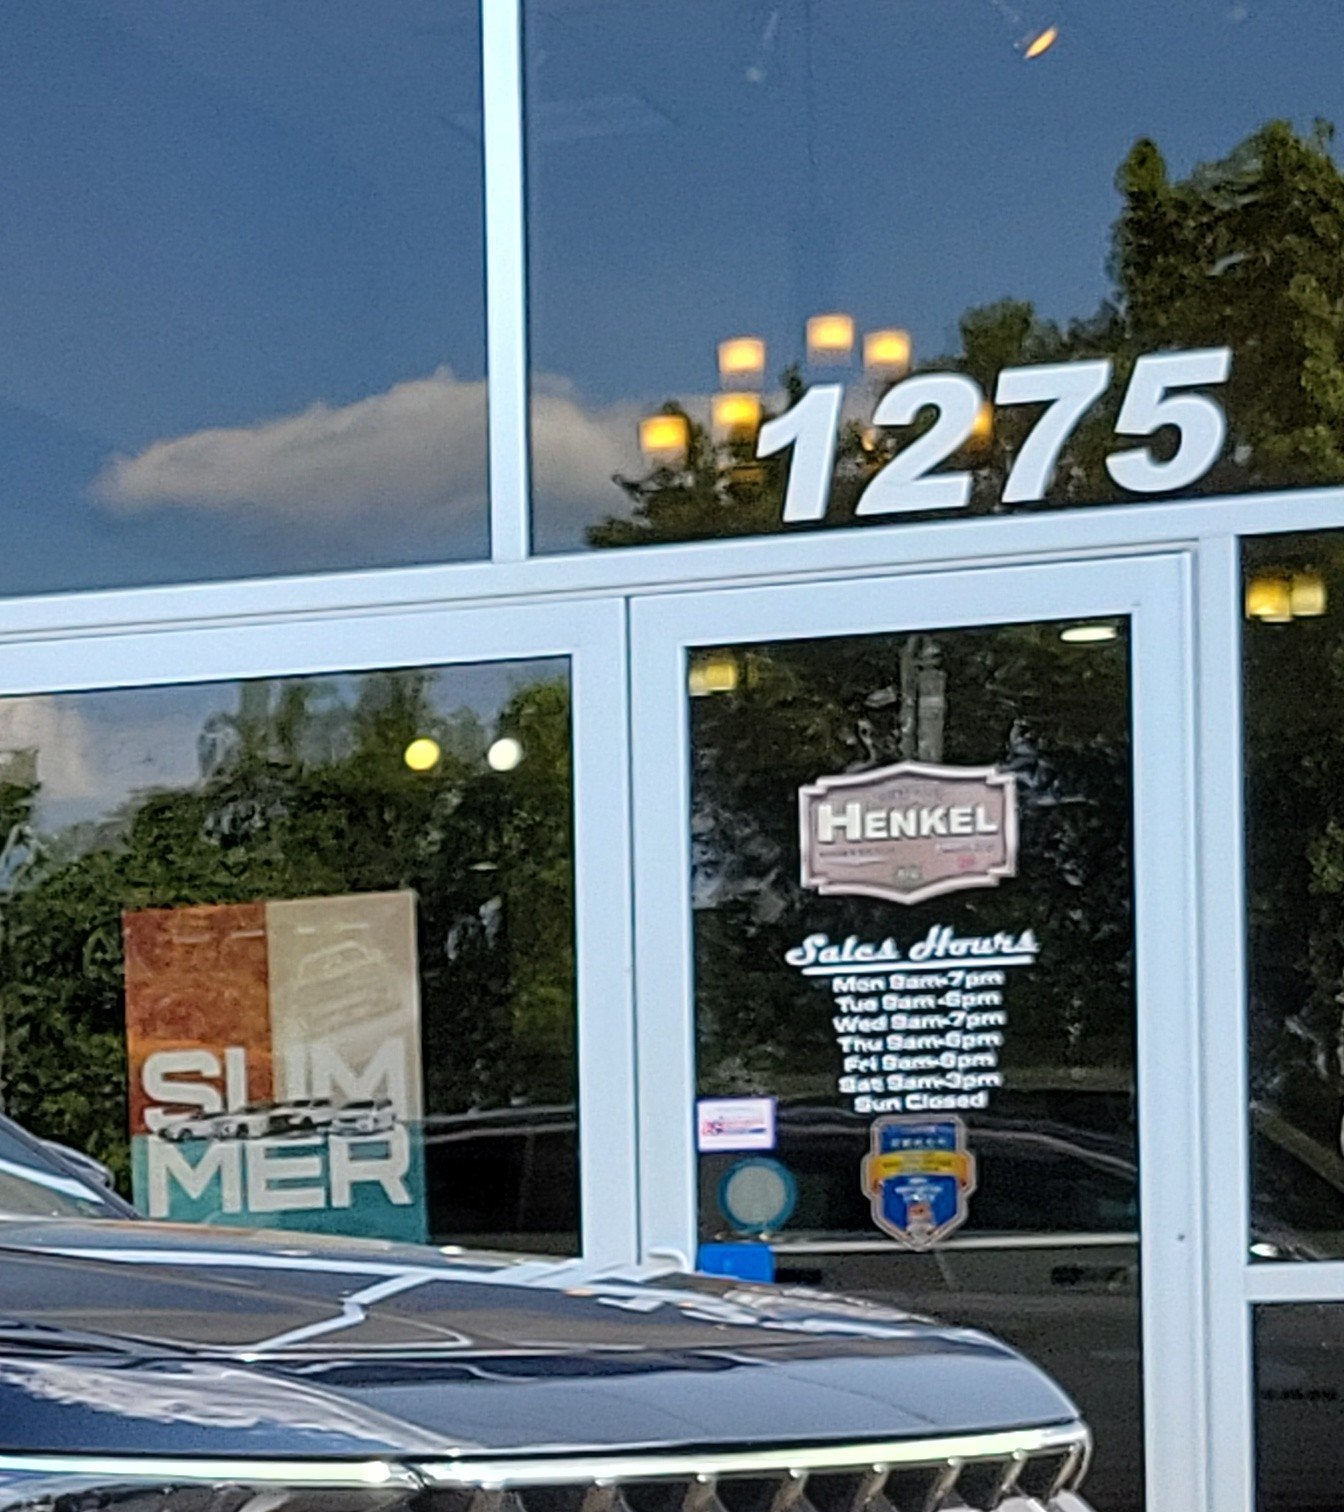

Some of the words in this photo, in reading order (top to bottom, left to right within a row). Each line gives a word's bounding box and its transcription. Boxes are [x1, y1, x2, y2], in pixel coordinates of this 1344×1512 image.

[757, 346, 1232, 523] 1275
[818, 802, 998, 843] HENKEL
[785, 933, 900, 966] Sales
[908, 924, 1039, 961] Hours
[832, 976, 886, 993] Mon
[835, 996, 879, 1013] Tue
[832, 1016, 887, 1033] Wed
[837, 1036, 883, 1053] Thu
[844, 1055, 878, 1073] Fri
[839, 1076, 884, 1093] Sat
[854, 1096, 902, 1113] Sun
[905, 1091, 989, 1110] Closed
[147, 1124, 413, 1219] MER
